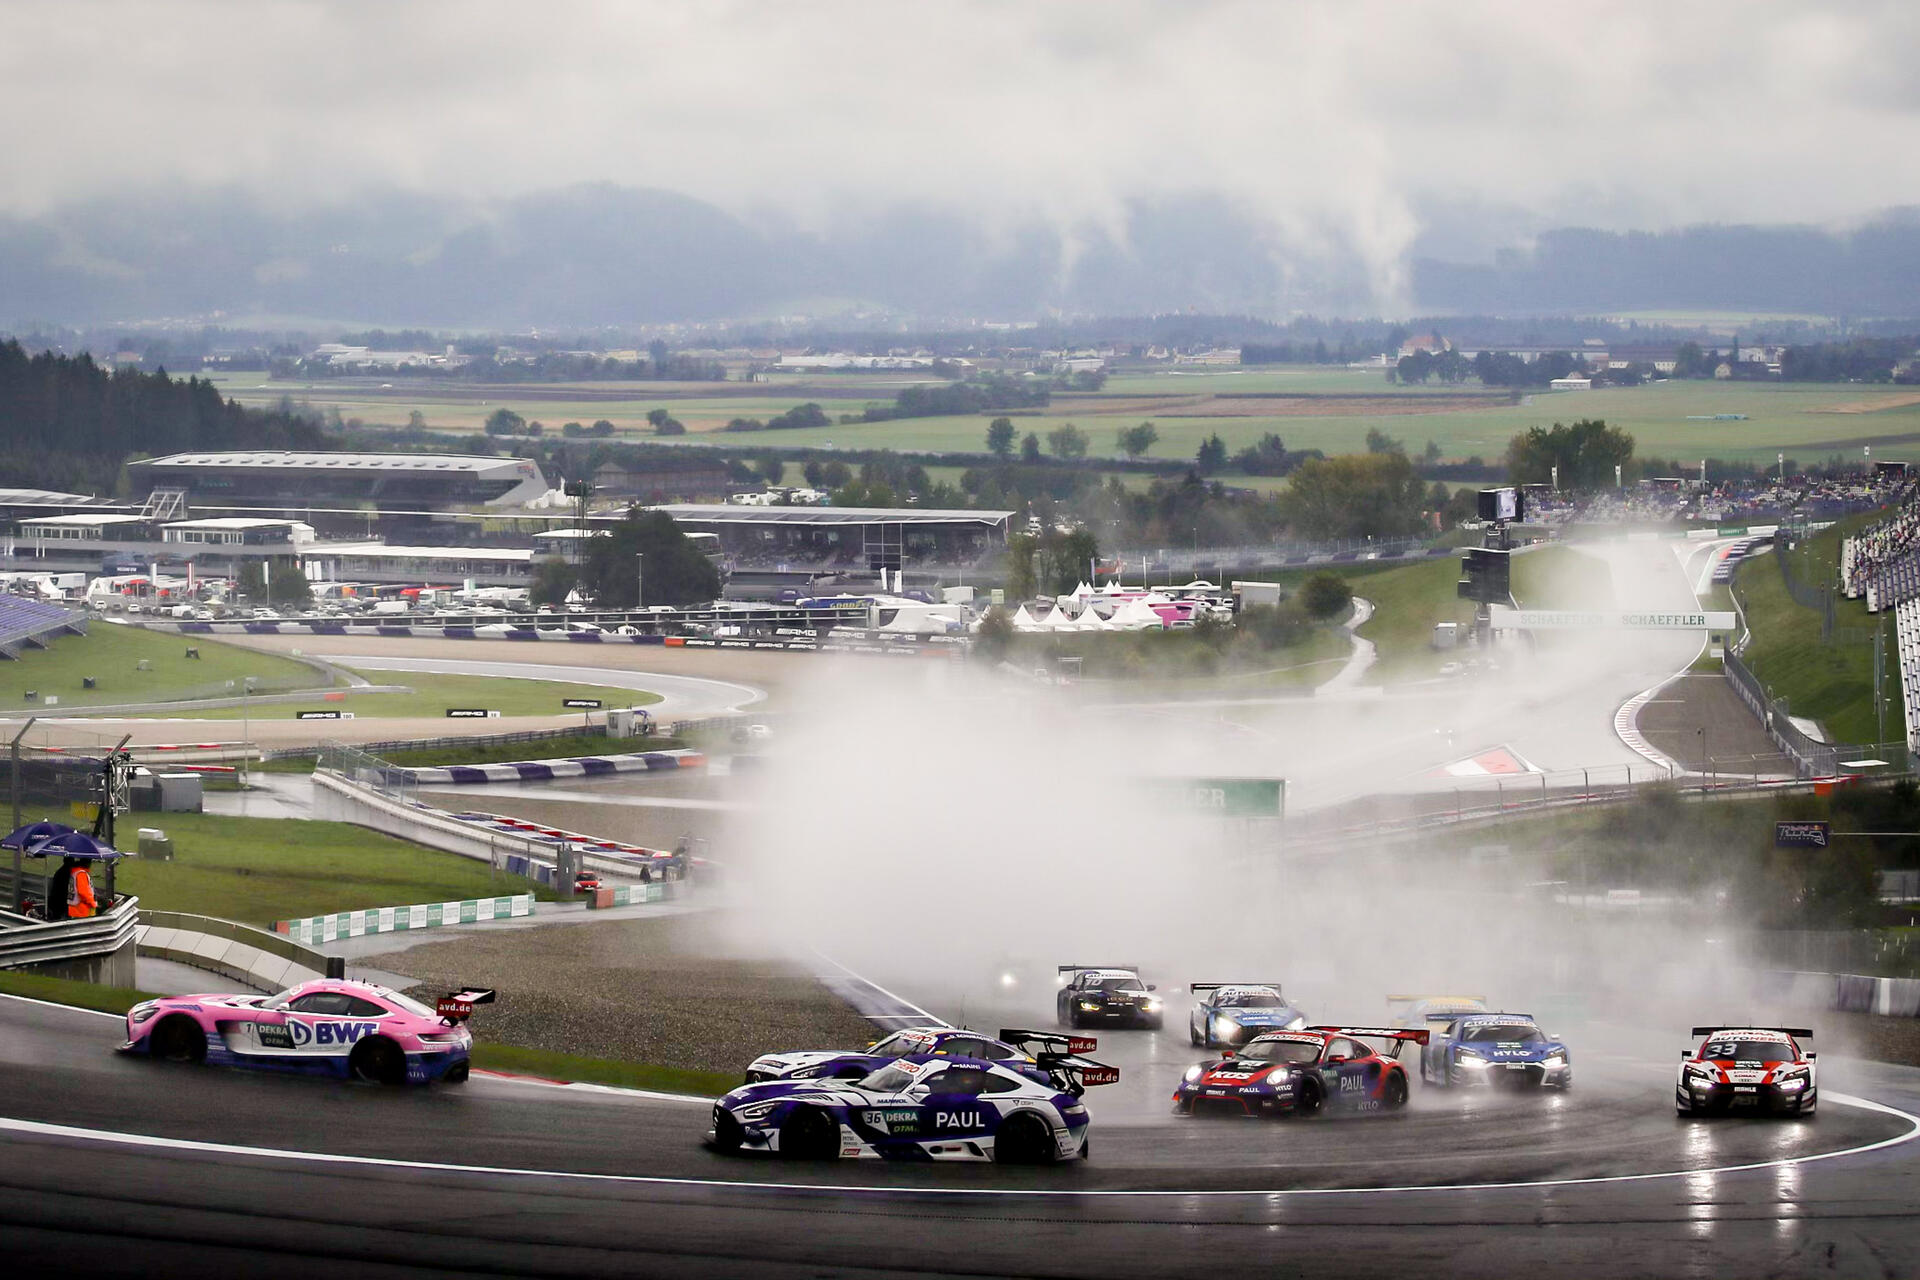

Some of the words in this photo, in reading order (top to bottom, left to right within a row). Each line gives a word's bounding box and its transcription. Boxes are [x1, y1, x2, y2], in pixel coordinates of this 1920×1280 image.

[1621, 614, 1705, 625] SCHAEFFLER
[789, 629, 817, 638] AMG
[439, 1003, 470, 1012] avd.de
[258, 1025, 288, 1036] DEKRA
[316, 1022, 377, 1044] BWT
[1069, 1041, 1096, 1050] avd.de
[1084, 1072, 1118, 1082] avd.de
[1340, 1074, 1365, 1092] PAUL
[867, 1112, 882, 1124] 36
[886, 1112, 918, 1122] DEKRA
[936, 1111, 986, 1128] PAUL
